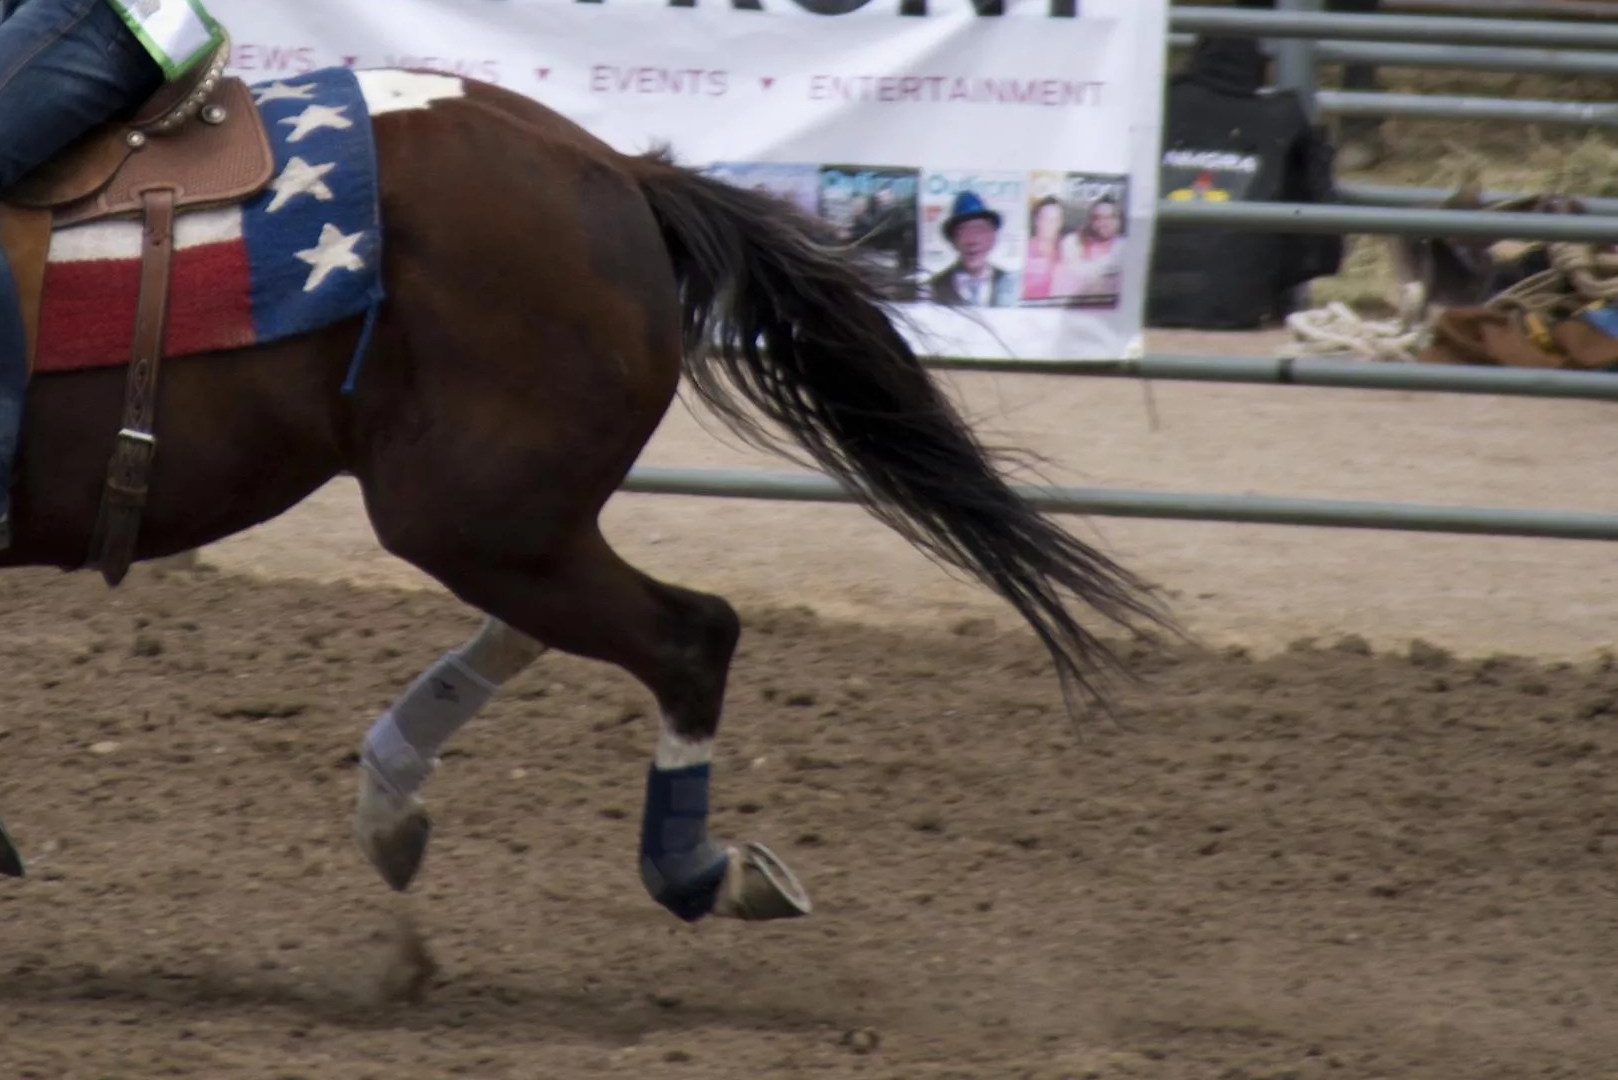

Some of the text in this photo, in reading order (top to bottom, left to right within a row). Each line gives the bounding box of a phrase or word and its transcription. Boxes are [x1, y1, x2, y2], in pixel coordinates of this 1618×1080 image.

[229, 44, 317, 73] EWS
[589, 64, 730, 97] EVENTS
[808, 74, 1106, 107] ENTERTAINMENT
